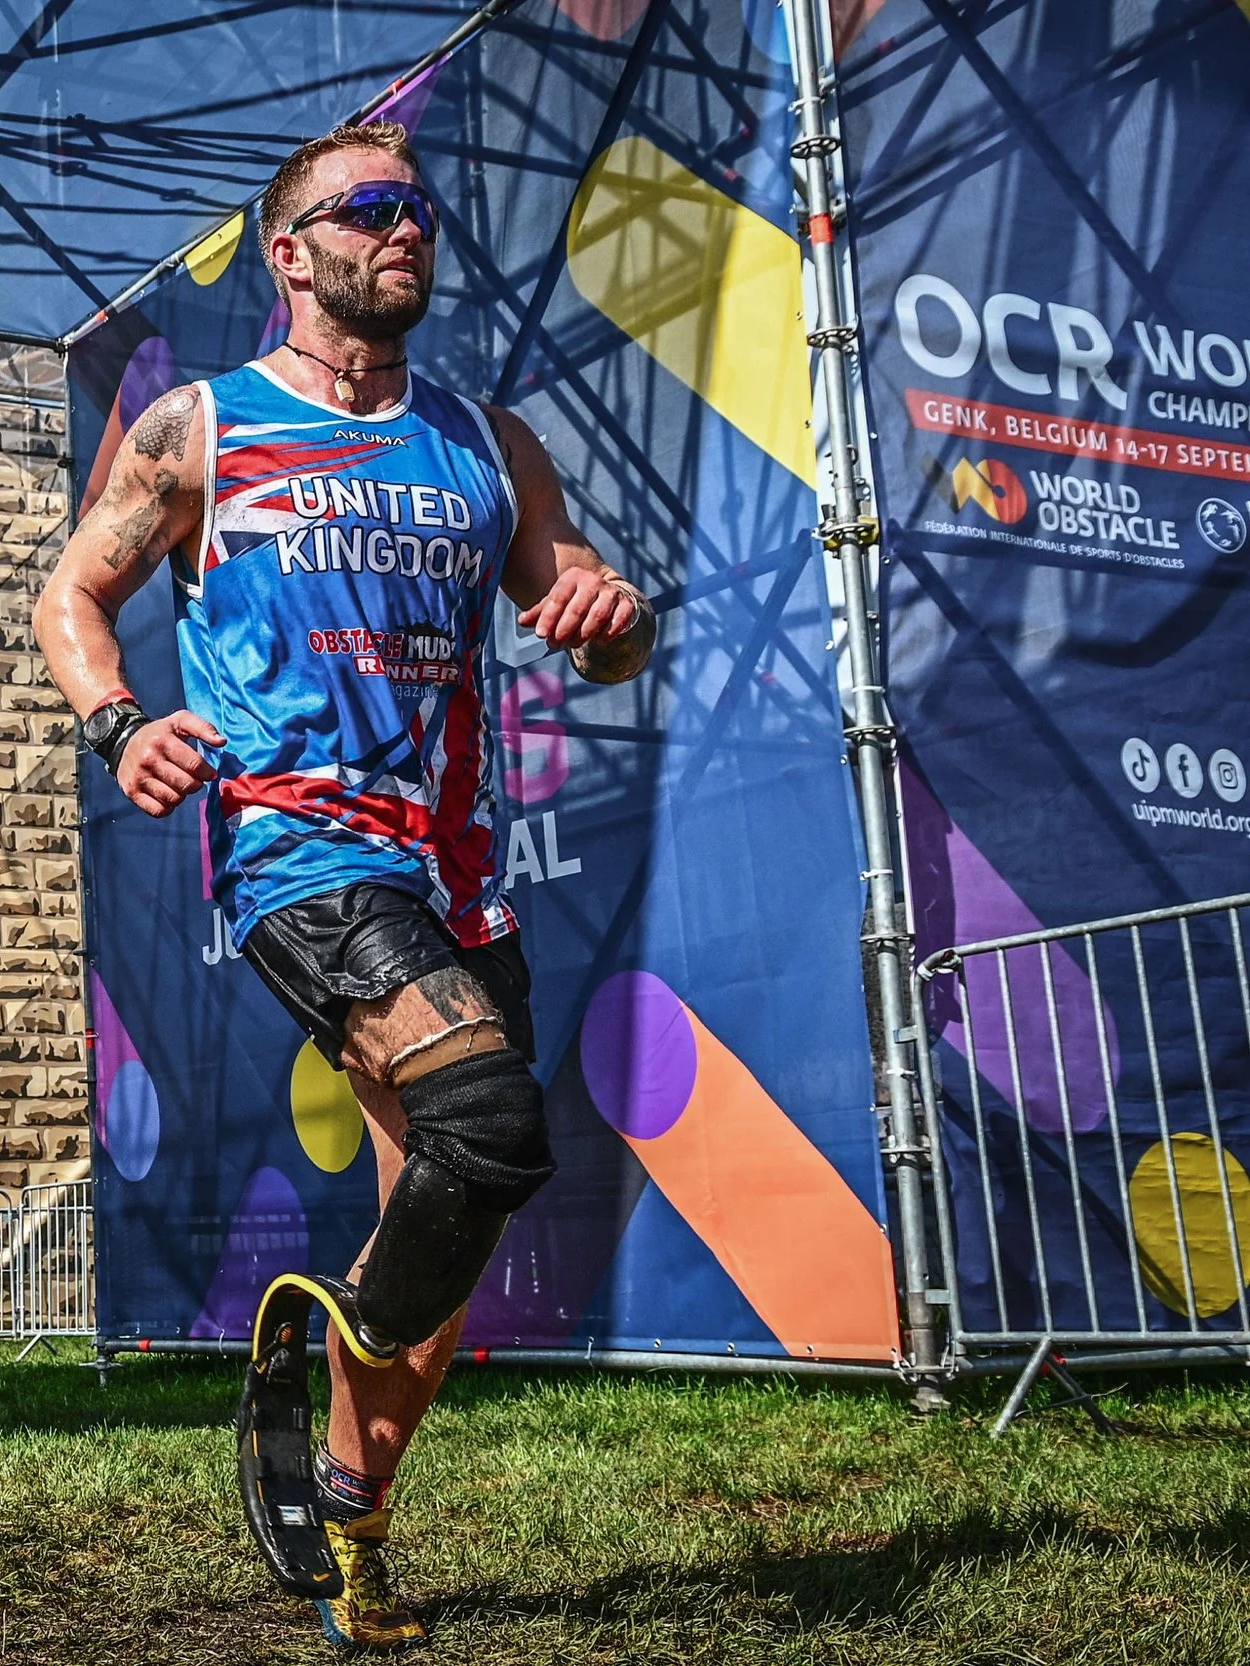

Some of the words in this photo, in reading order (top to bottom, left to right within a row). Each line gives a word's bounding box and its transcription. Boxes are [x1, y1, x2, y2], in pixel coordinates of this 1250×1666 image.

[894, 273, 1128, 411] OCR
[1134, 320, 1250, 388] WO
[924, 399, 996, 436] GENK,
[1005, 415, 1108, 452] BELGIUM
[1116, 437, 1169, 465] 14-17
[1147, 390, 1250, 431] CHAMP
[333, 428, 408, 447] AKUMA
[289, 477, 472, 531] UNITED
[1029, 470, 1141, 514] WORLD
[925, 519, 987, 539] FÉDÉRATION
[990, 530, 1067, 554] INTERNATIONALE
[1070, 544, 1083, 556] DE
[1084, 546, 1122, 561] SPORTS
[1123, 552, 1185, 569] D'OBSTACLES
[1037, 500, 1180, 549] OBSTACLE
[275, 527, 484, 589] KINGDOM
[308, 628, 405, 659] OBSTACLE
